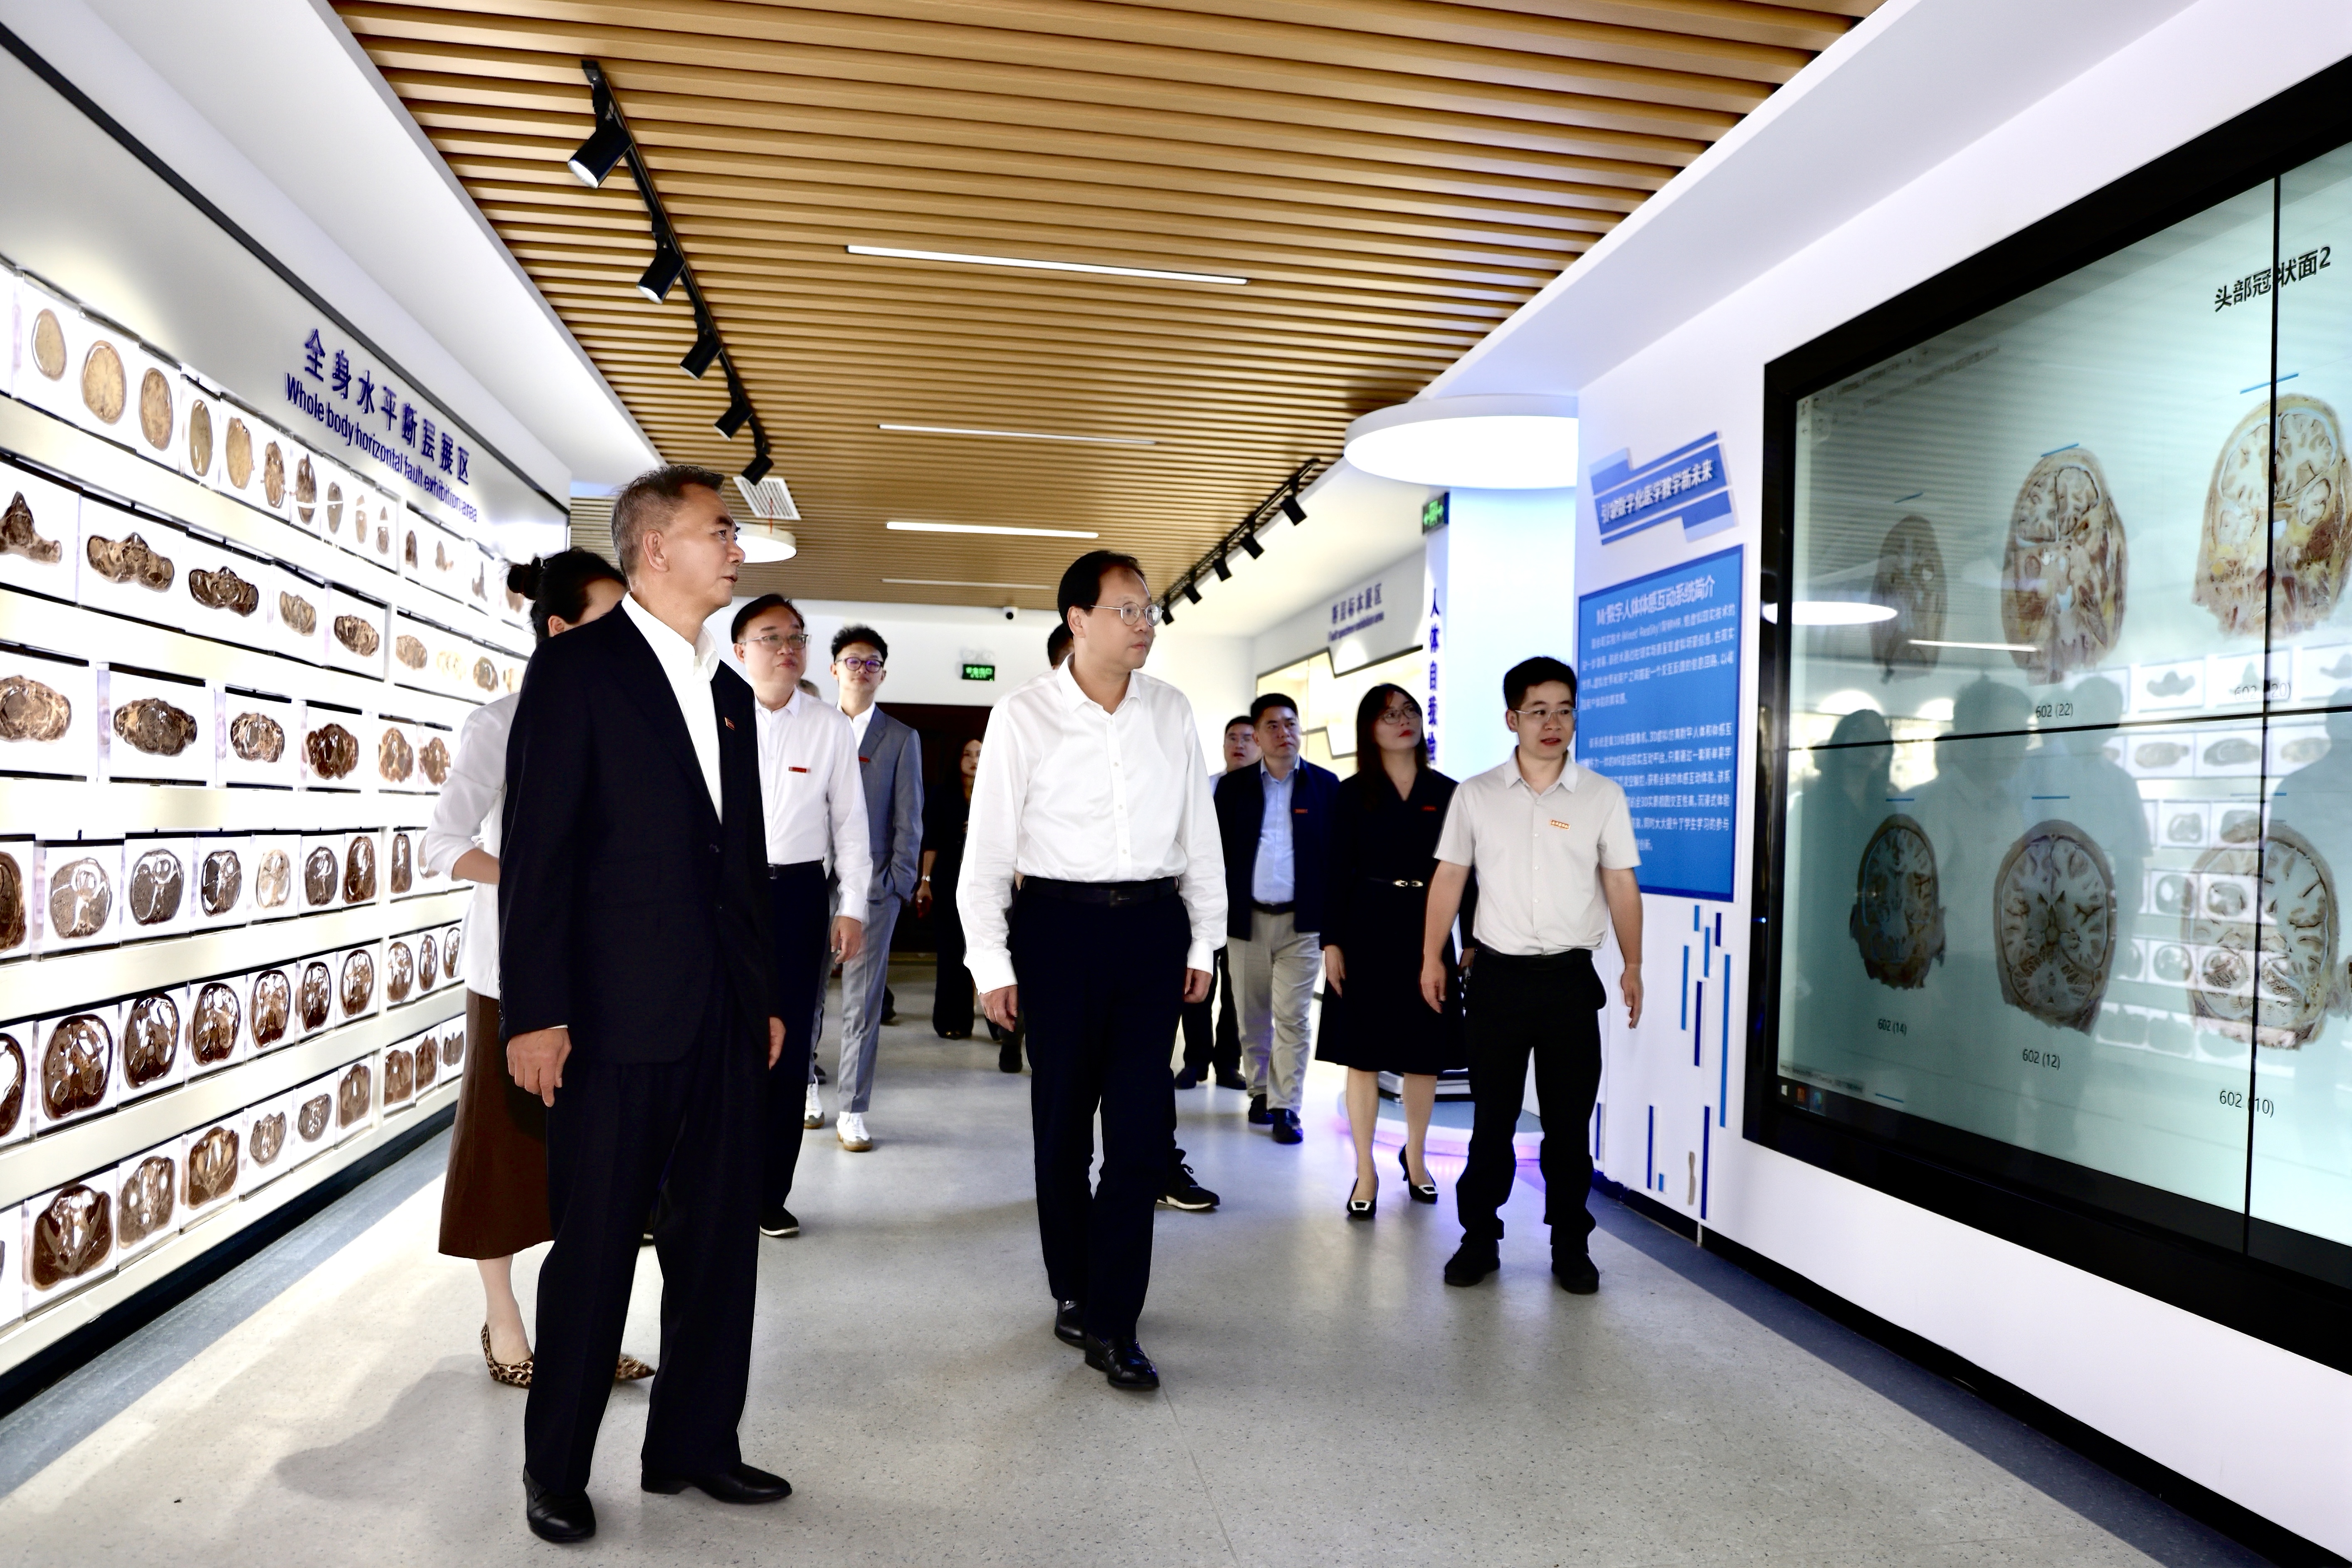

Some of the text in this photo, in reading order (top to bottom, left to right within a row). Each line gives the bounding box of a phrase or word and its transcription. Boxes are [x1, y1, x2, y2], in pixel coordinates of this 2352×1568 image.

[2214, 247, 2331, 312] 头部冠状面2
[305, 328, 470, 485] 全身水平断层展区
[285, 373, 477, 522] Whole body horizontal fault exhibition area
[2235, 683, 2291, 700] 602 20)
[2036, 703, 2073, 719] 602 (22)
[1878, 1019, 1907, 1036] 602 (14)
[2022, 1049, 2060, 1070] 602 (12)
[2220, 1090, 2242, 1108] 602
